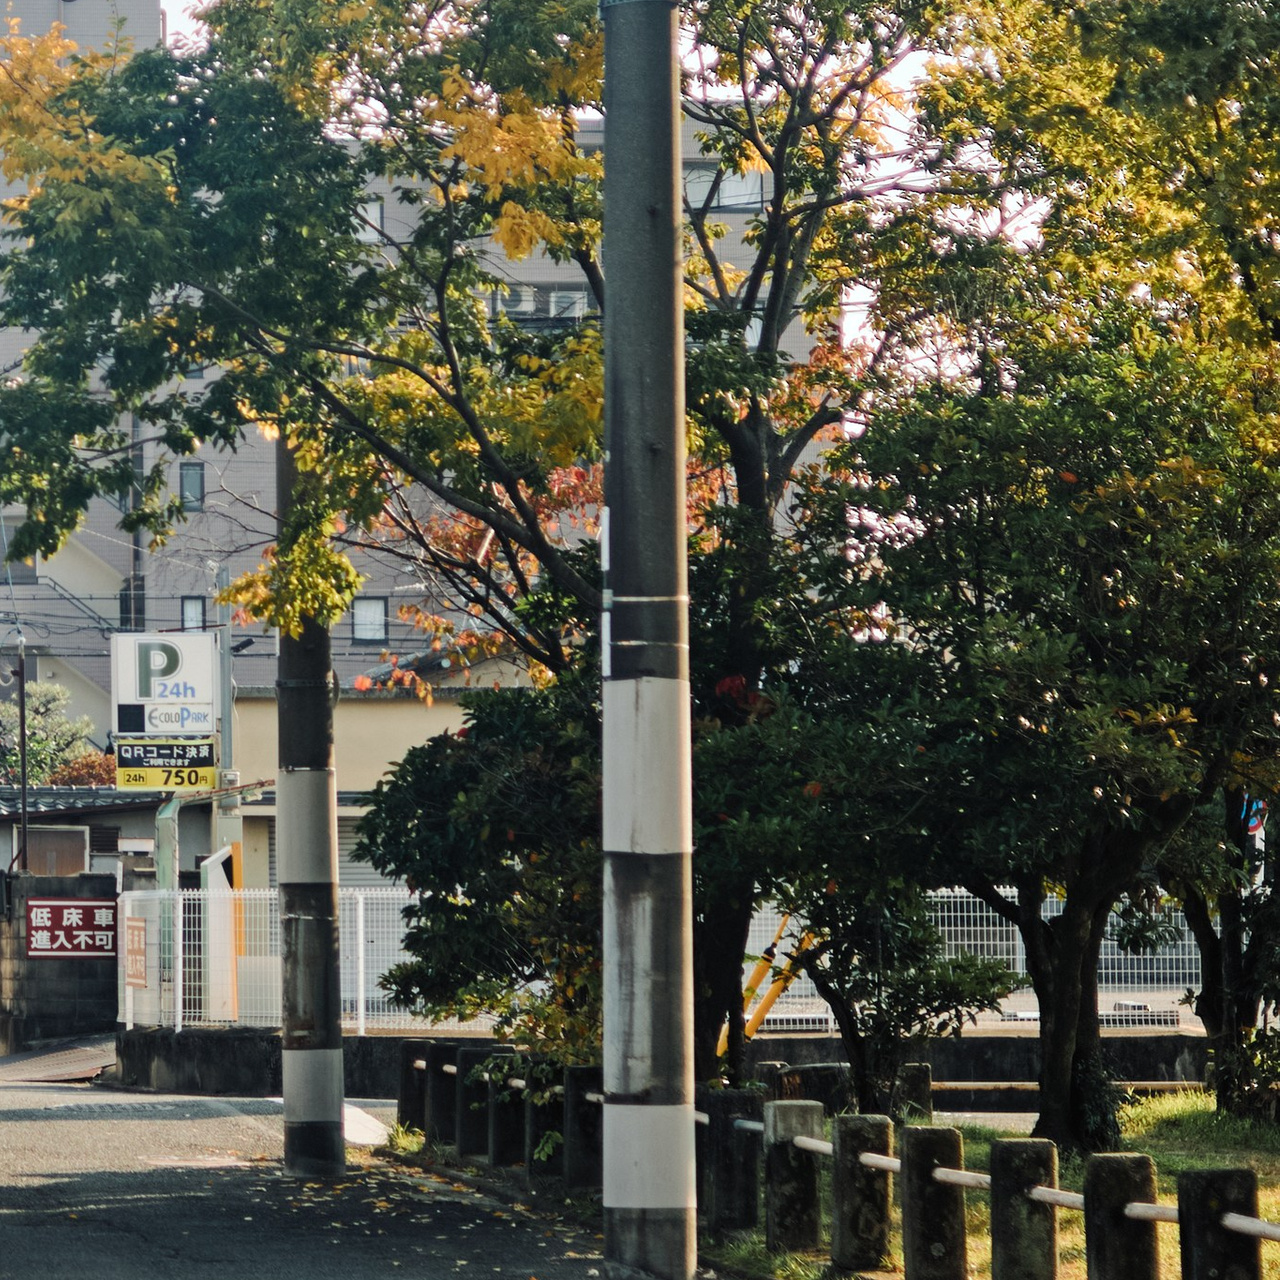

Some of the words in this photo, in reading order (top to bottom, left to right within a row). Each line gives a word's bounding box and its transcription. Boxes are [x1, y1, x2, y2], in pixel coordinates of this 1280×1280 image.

[136, 640, 182, 700] P
[157, 681, 196, 699] 24h
[121, 745, 210, 759] QRコード決済
[142, 758, 191, 767] ご利用できます
[125, 773, 145, 783] 24h
[30, 907, 114, 927] 低床車
[30, 930, 114, 950] 進入不可
